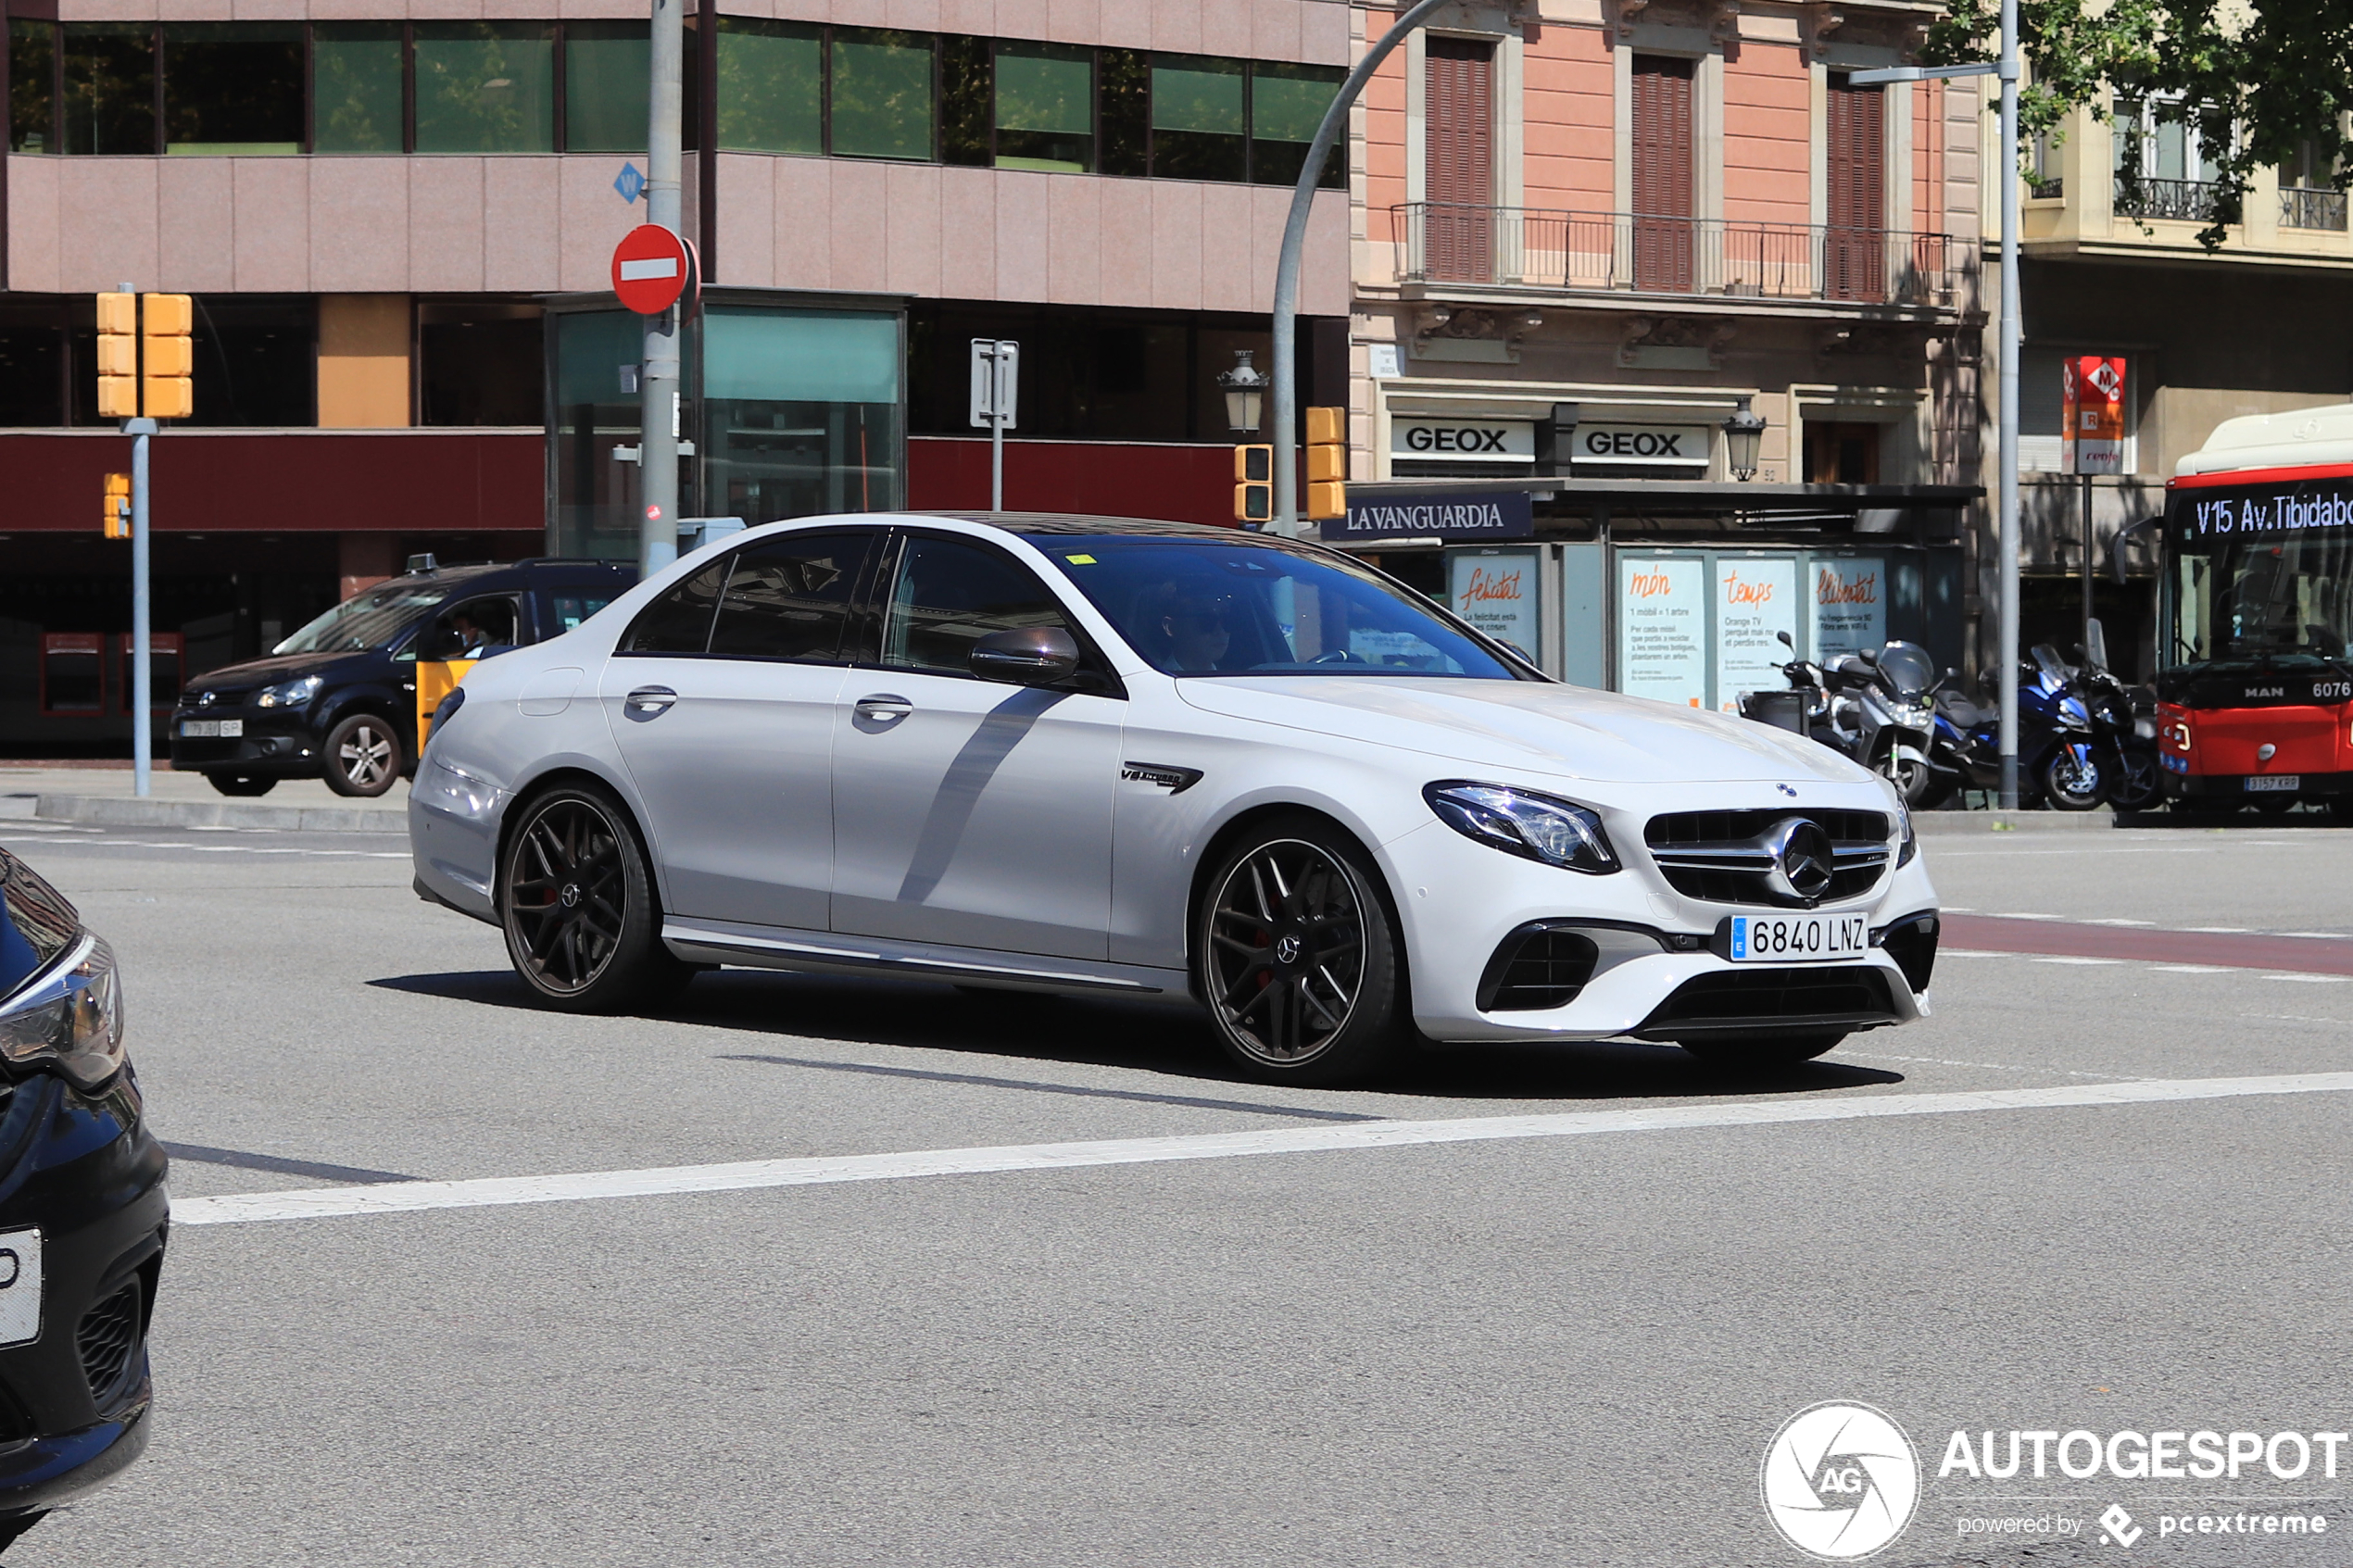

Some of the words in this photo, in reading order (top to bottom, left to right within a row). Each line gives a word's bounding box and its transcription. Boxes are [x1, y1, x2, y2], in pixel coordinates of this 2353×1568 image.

[620, 173, 637, 193] W
[2098, 370, 2111, 386] M
[2087, 414, 2096, 426] R
[1406, 427, 1507, 452] GEOX
[1587, 432, 1681, 457] GEOX
[2086, 449, 2119, 464] renfe
[1347, 506, 1373, 531] LA
[1370, 503, 1504, 530] VANGUARDIA
[2196, 499, 2233, 534] V15
[1459, 568, 1522, 610] felicitat
[1629, 564, 1671, 598] món
[1723, 569, 1773, 610] temps
[1818, 569, 1877, 605] llibertat
[1725, 616, 1751, 627] Orange
[1752, 617, 1762, 626] TV
[2245, 687, 2284, 698] MAN
[2312, 682, 2352, 698] 6076
[1121, 769, 1140, 781] V8
[1736, 942, 1743, 952] E
[1753, 921, 1820, 954] 6840
[1828, 918, 1864, 952] LNZ
